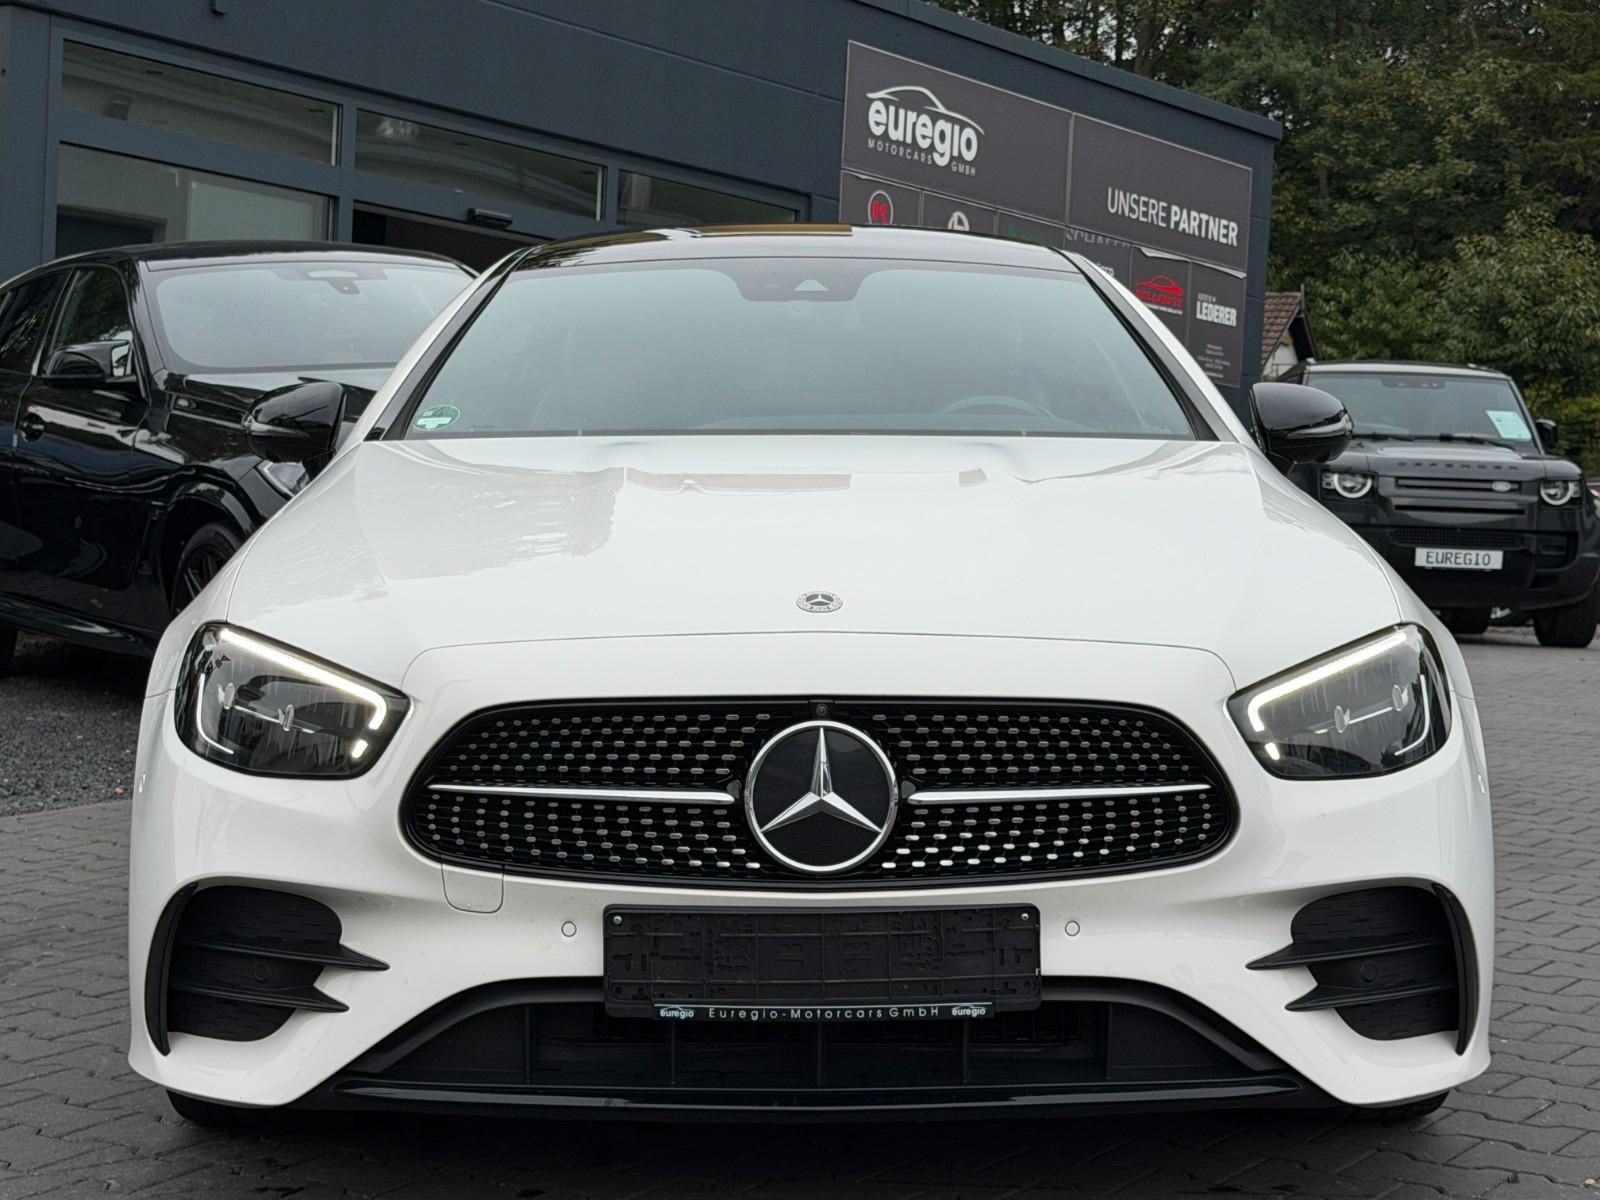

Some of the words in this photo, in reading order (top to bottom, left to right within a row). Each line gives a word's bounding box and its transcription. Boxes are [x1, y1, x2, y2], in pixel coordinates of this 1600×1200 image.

[868, 100, 978, 167] euregio
[867, 138, 932, 165] MOTORCARS
[1107, 187, 1168, 228] UNSERE
[1169, 204, 1238, 247] PARTNER
[1196, 300, 1237, 327] LEDERER
[1426, 551, 1492, 567] EUREGIO
[659, 1008, 695, 1020] euregio
[889, 1006, 940, 1018] GmbH
[952, 1006, 986, 1018] euregio
